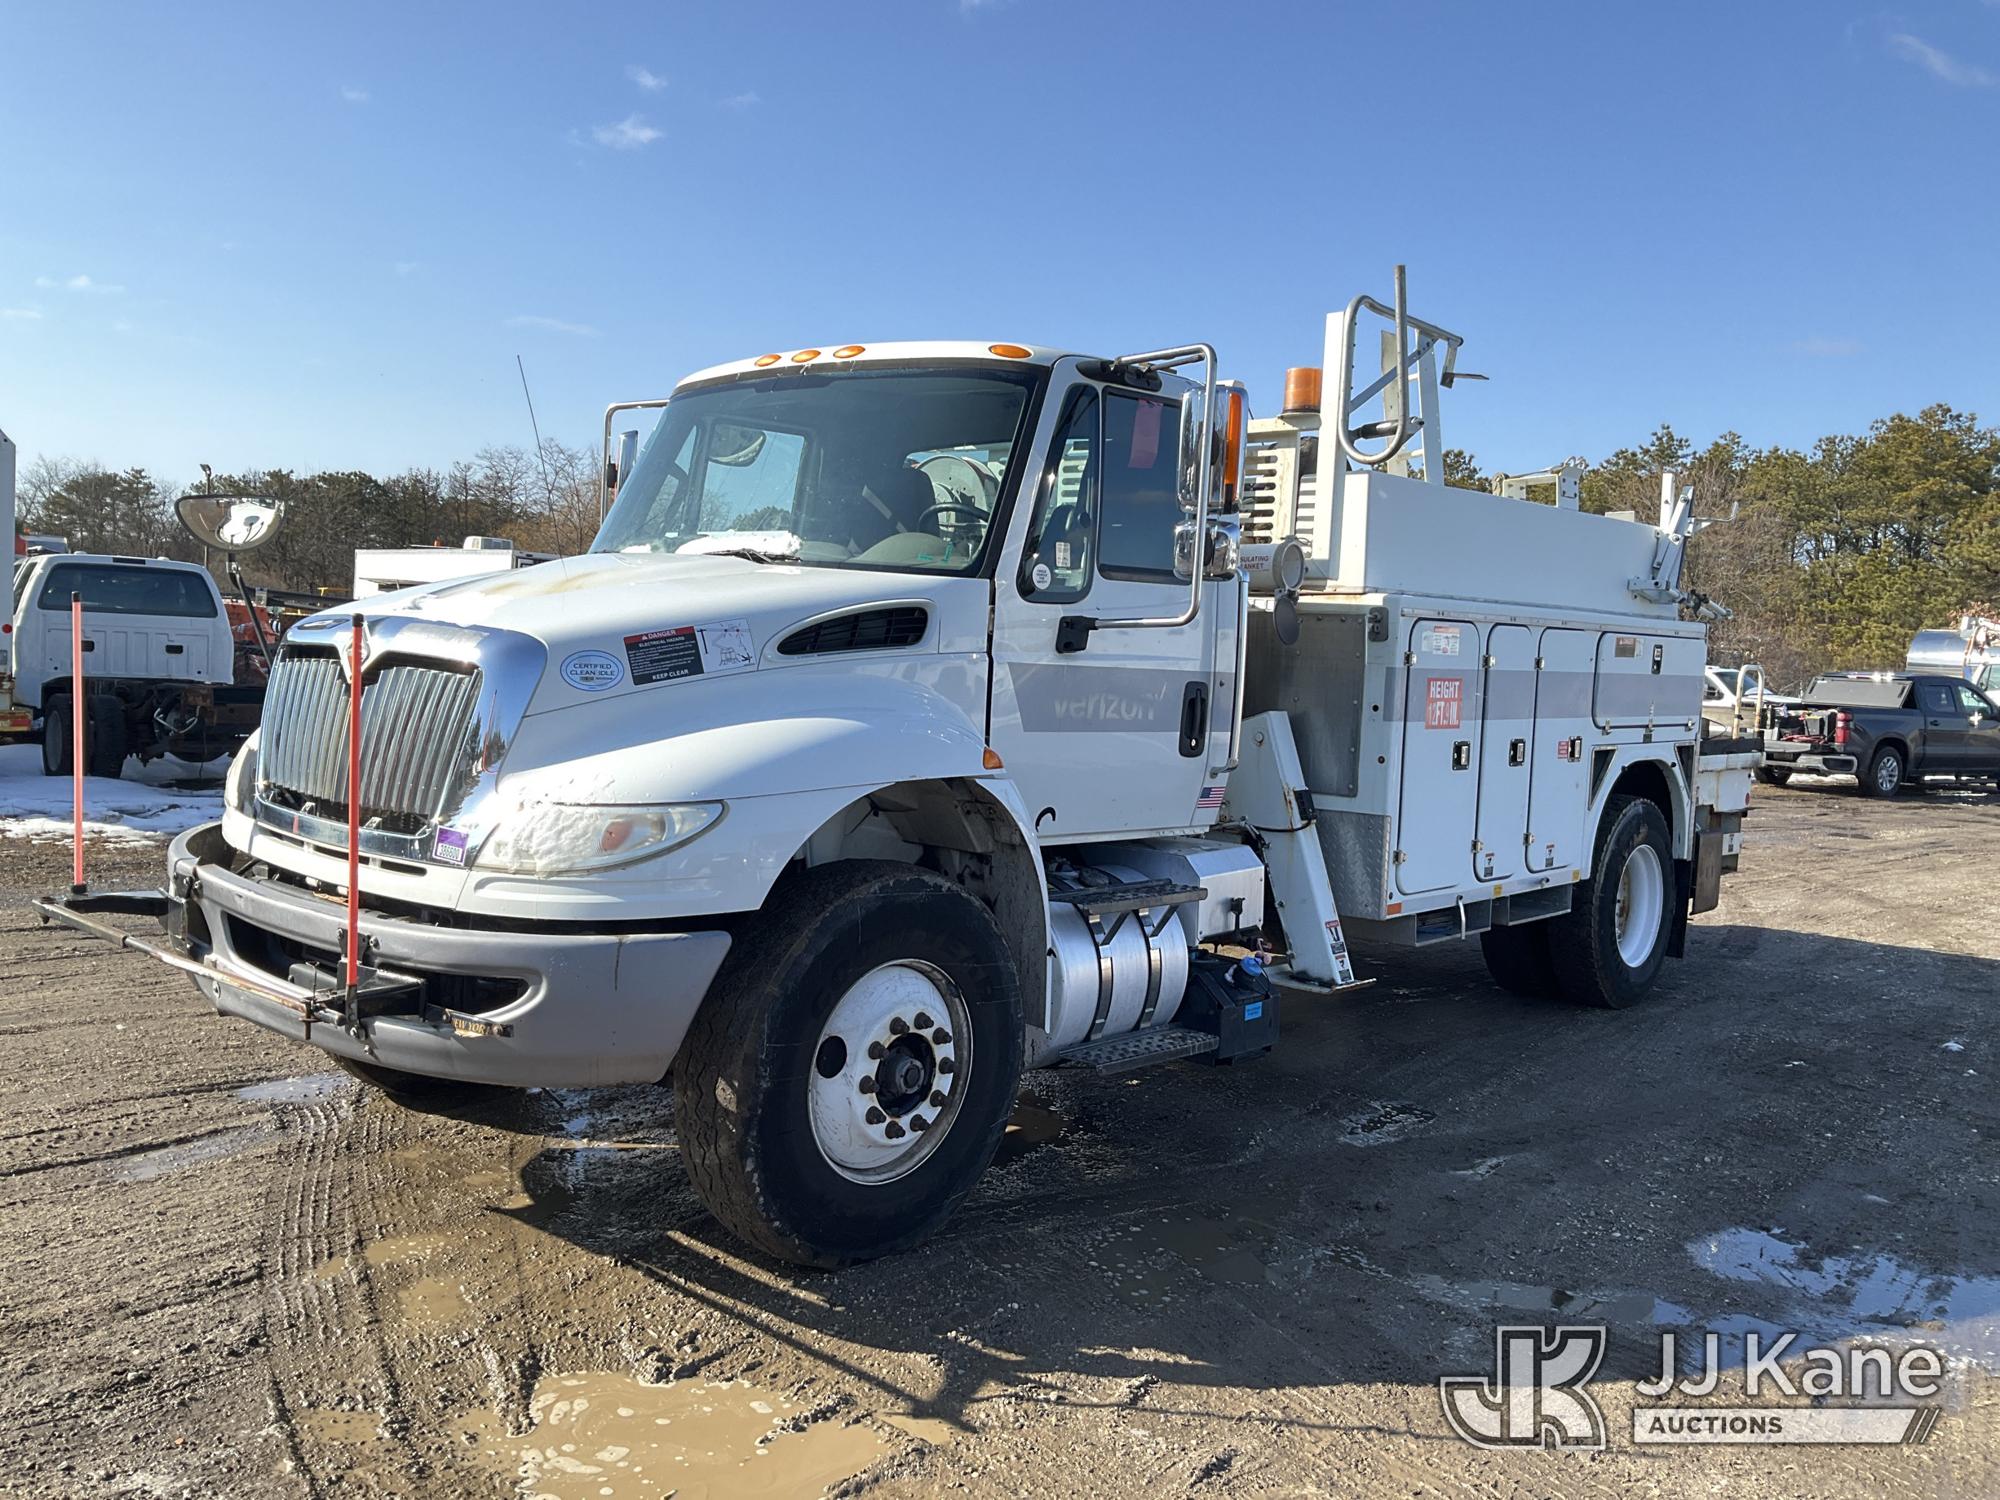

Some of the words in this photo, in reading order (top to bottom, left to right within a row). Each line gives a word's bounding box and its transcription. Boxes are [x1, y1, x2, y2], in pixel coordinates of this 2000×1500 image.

[648, 630, 677, 640] DANGER
[639, 639, 666, 648] ELECTRICAL
[652, 672, 669, 681] KEEP
[669, 669, 689, 678] CLEAR
[1430, 681, 1460, 699] HEIGHT
[1054, 692, 1154, 720] verizon
